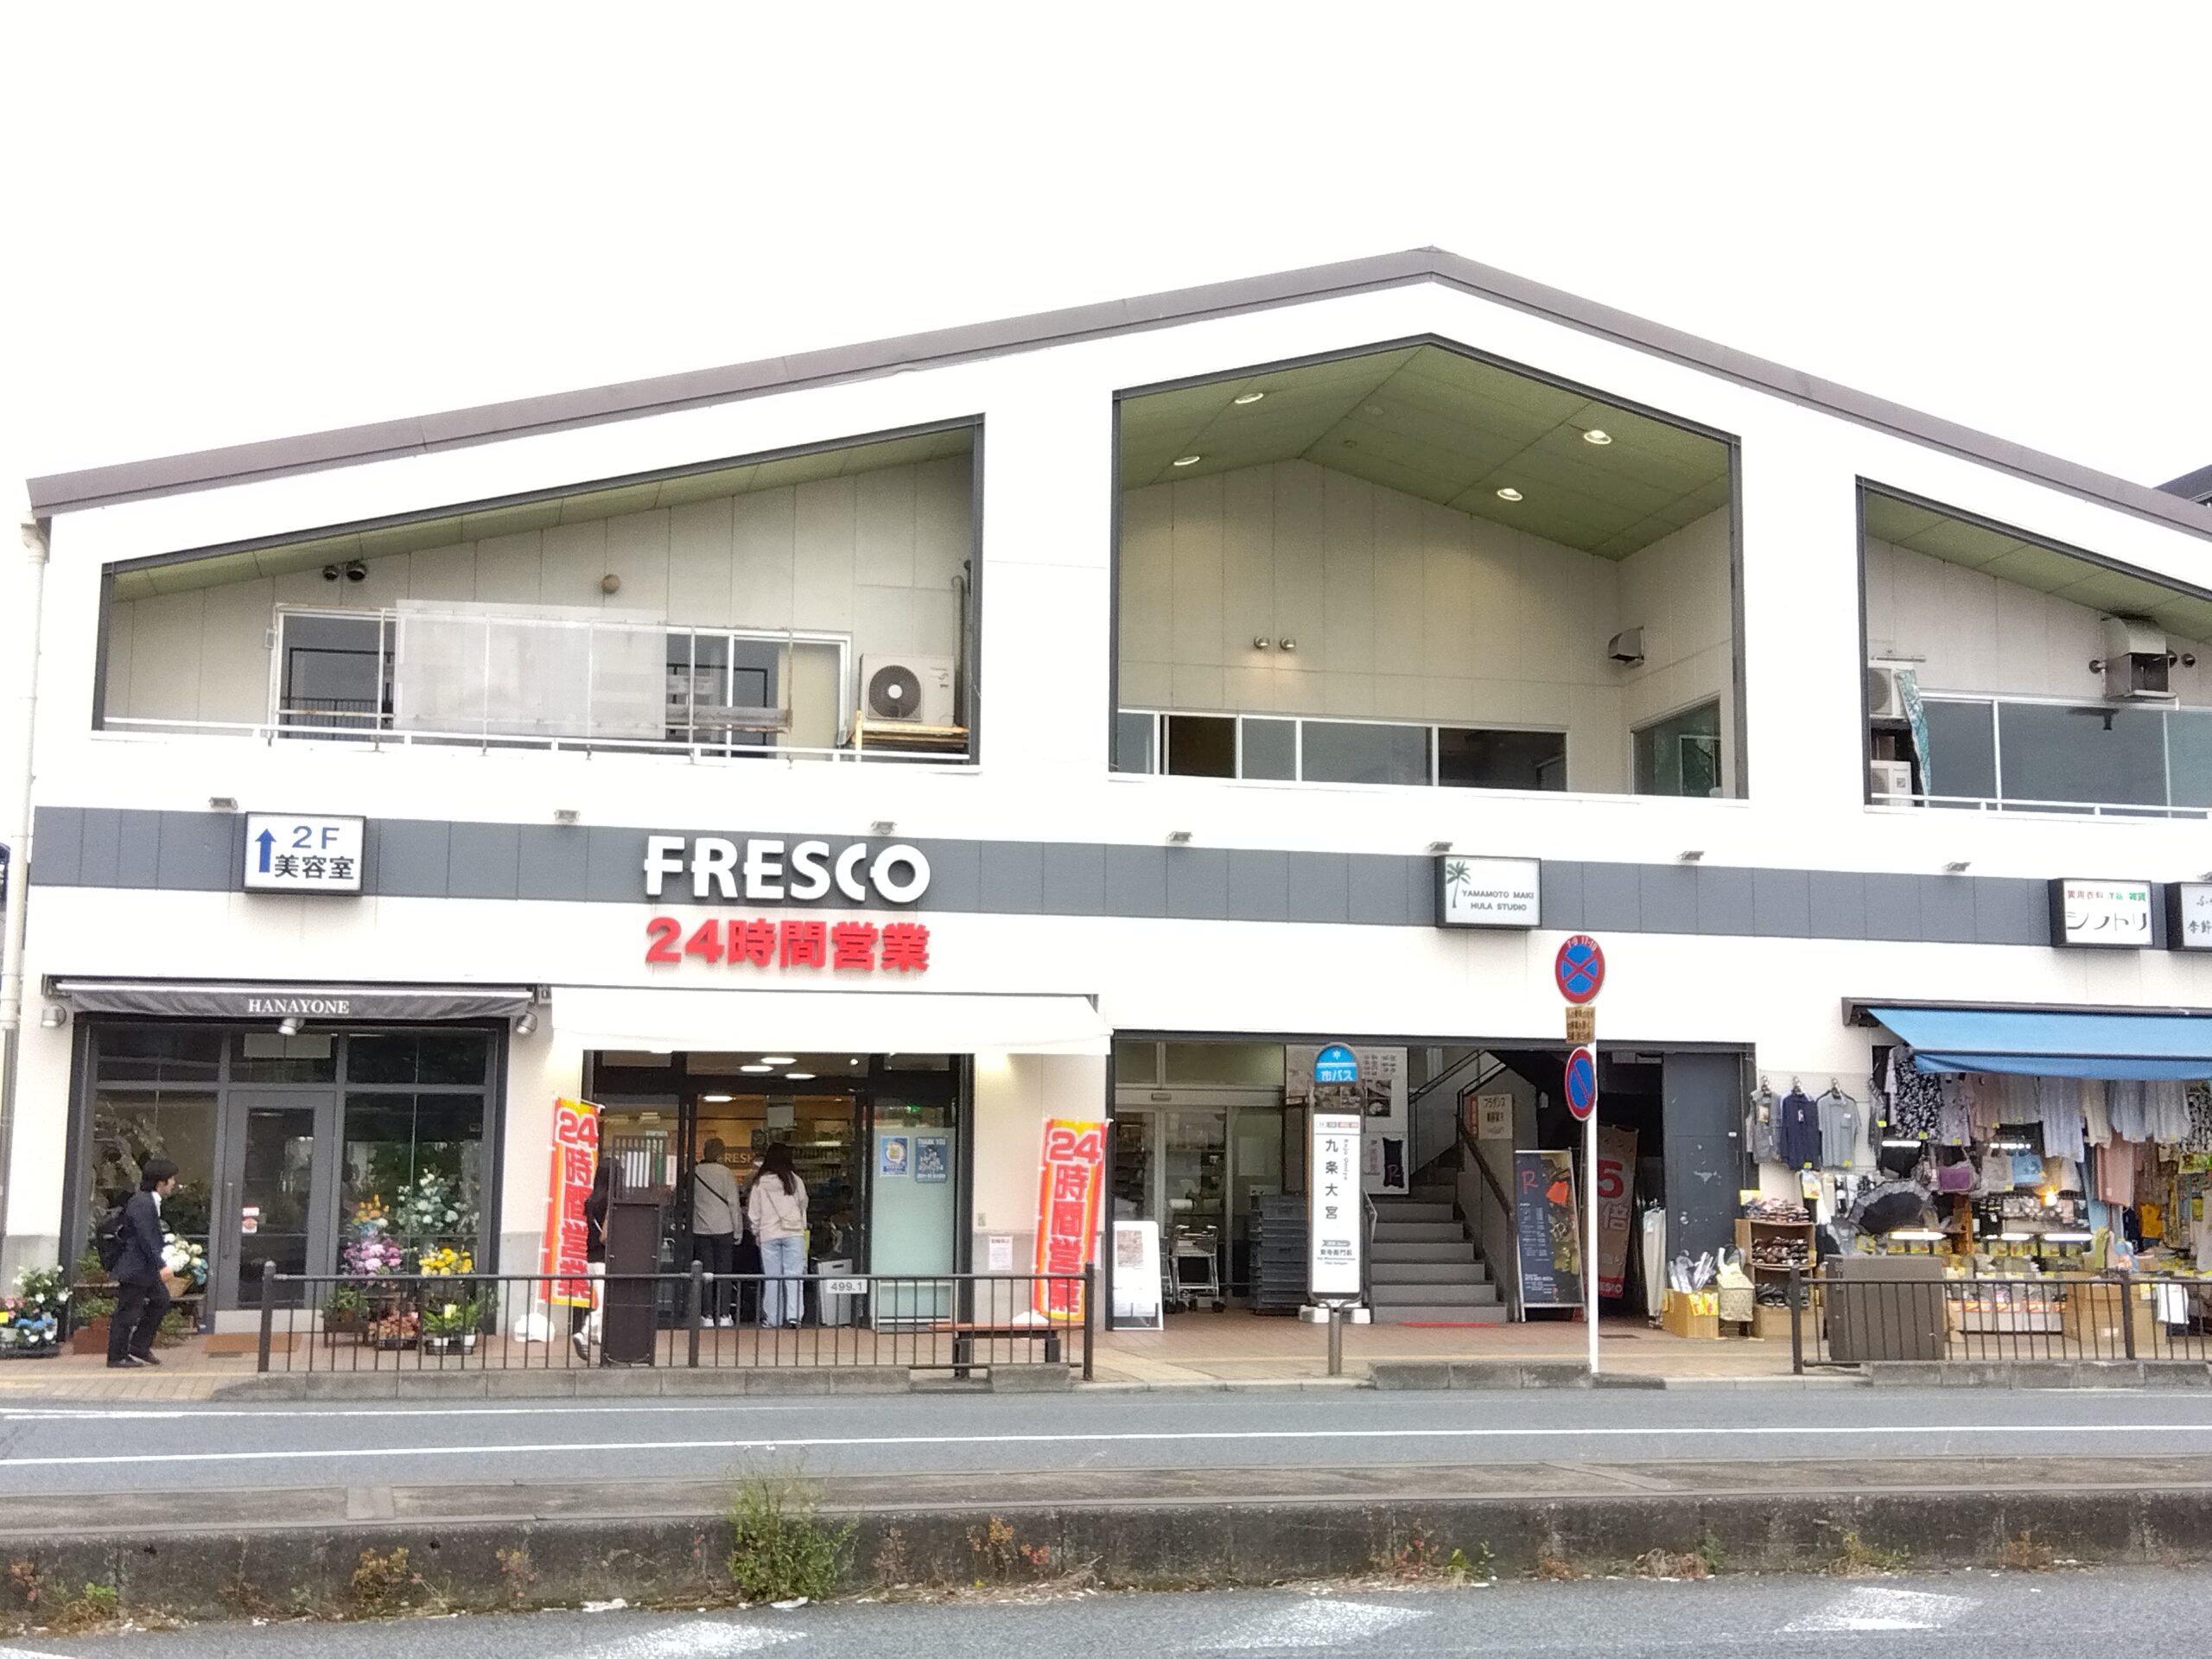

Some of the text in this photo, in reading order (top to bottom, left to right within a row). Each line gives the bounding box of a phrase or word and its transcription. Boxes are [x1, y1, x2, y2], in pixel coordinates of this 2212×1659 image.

[292, 826, 340, 849] 2F
[274, 854, 354, 880] 美容室
[644, 836, 931, 903] FRESCO
[1462, 889, 1510, 899] YAMAMOTO
[645, 917, 930, 973] 24時間営業
[248, 998, 350, 1014] HANAYONE
[1320, 1069, 1354, 1081] 市バス
[1325, 1138, 1338, 1219] 九条大宮
